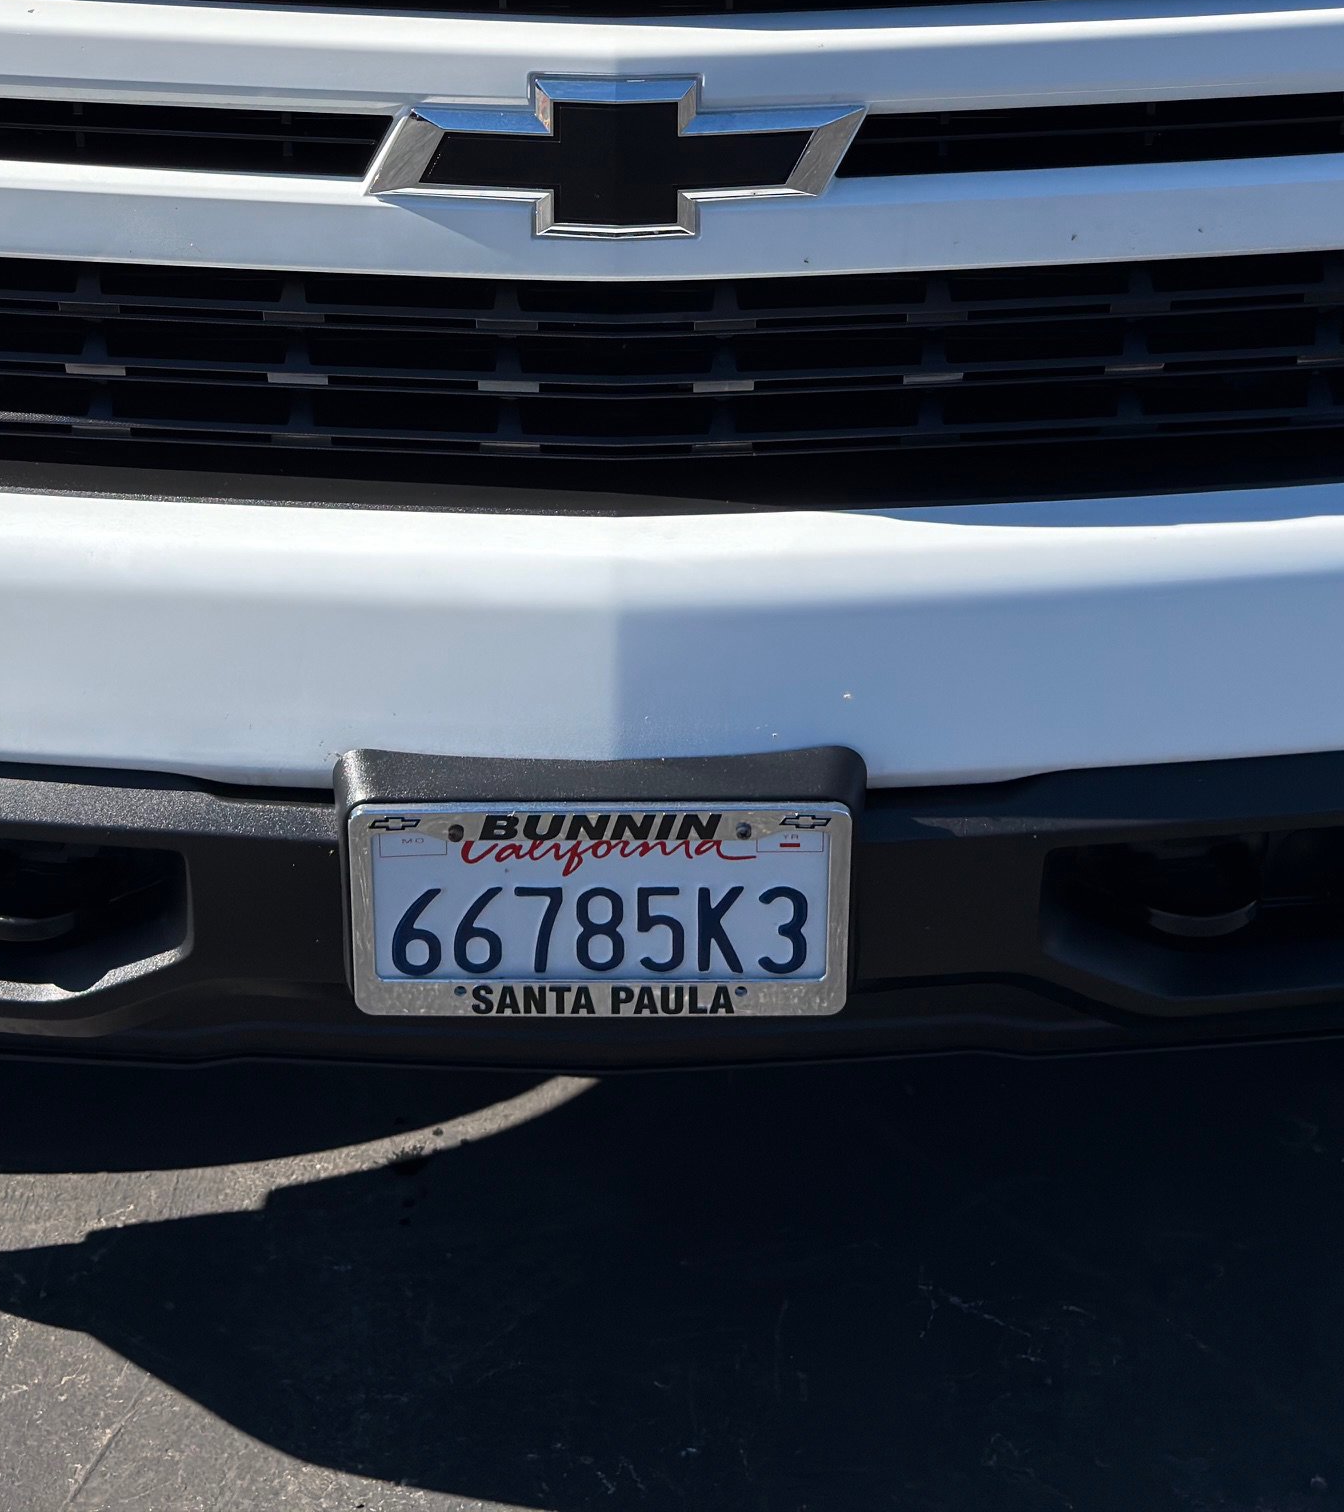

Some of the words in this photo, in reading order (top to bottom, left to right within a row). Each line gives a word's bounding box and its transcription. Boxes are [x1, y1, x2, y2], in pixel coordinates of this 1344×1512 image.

[479, 814, 722, 840] BUNNIN
[391, 885, 808, 976] 66785K3
[472, 985, 596, 1015] SANTA
[611, 985, 735, 1015] PAULA
